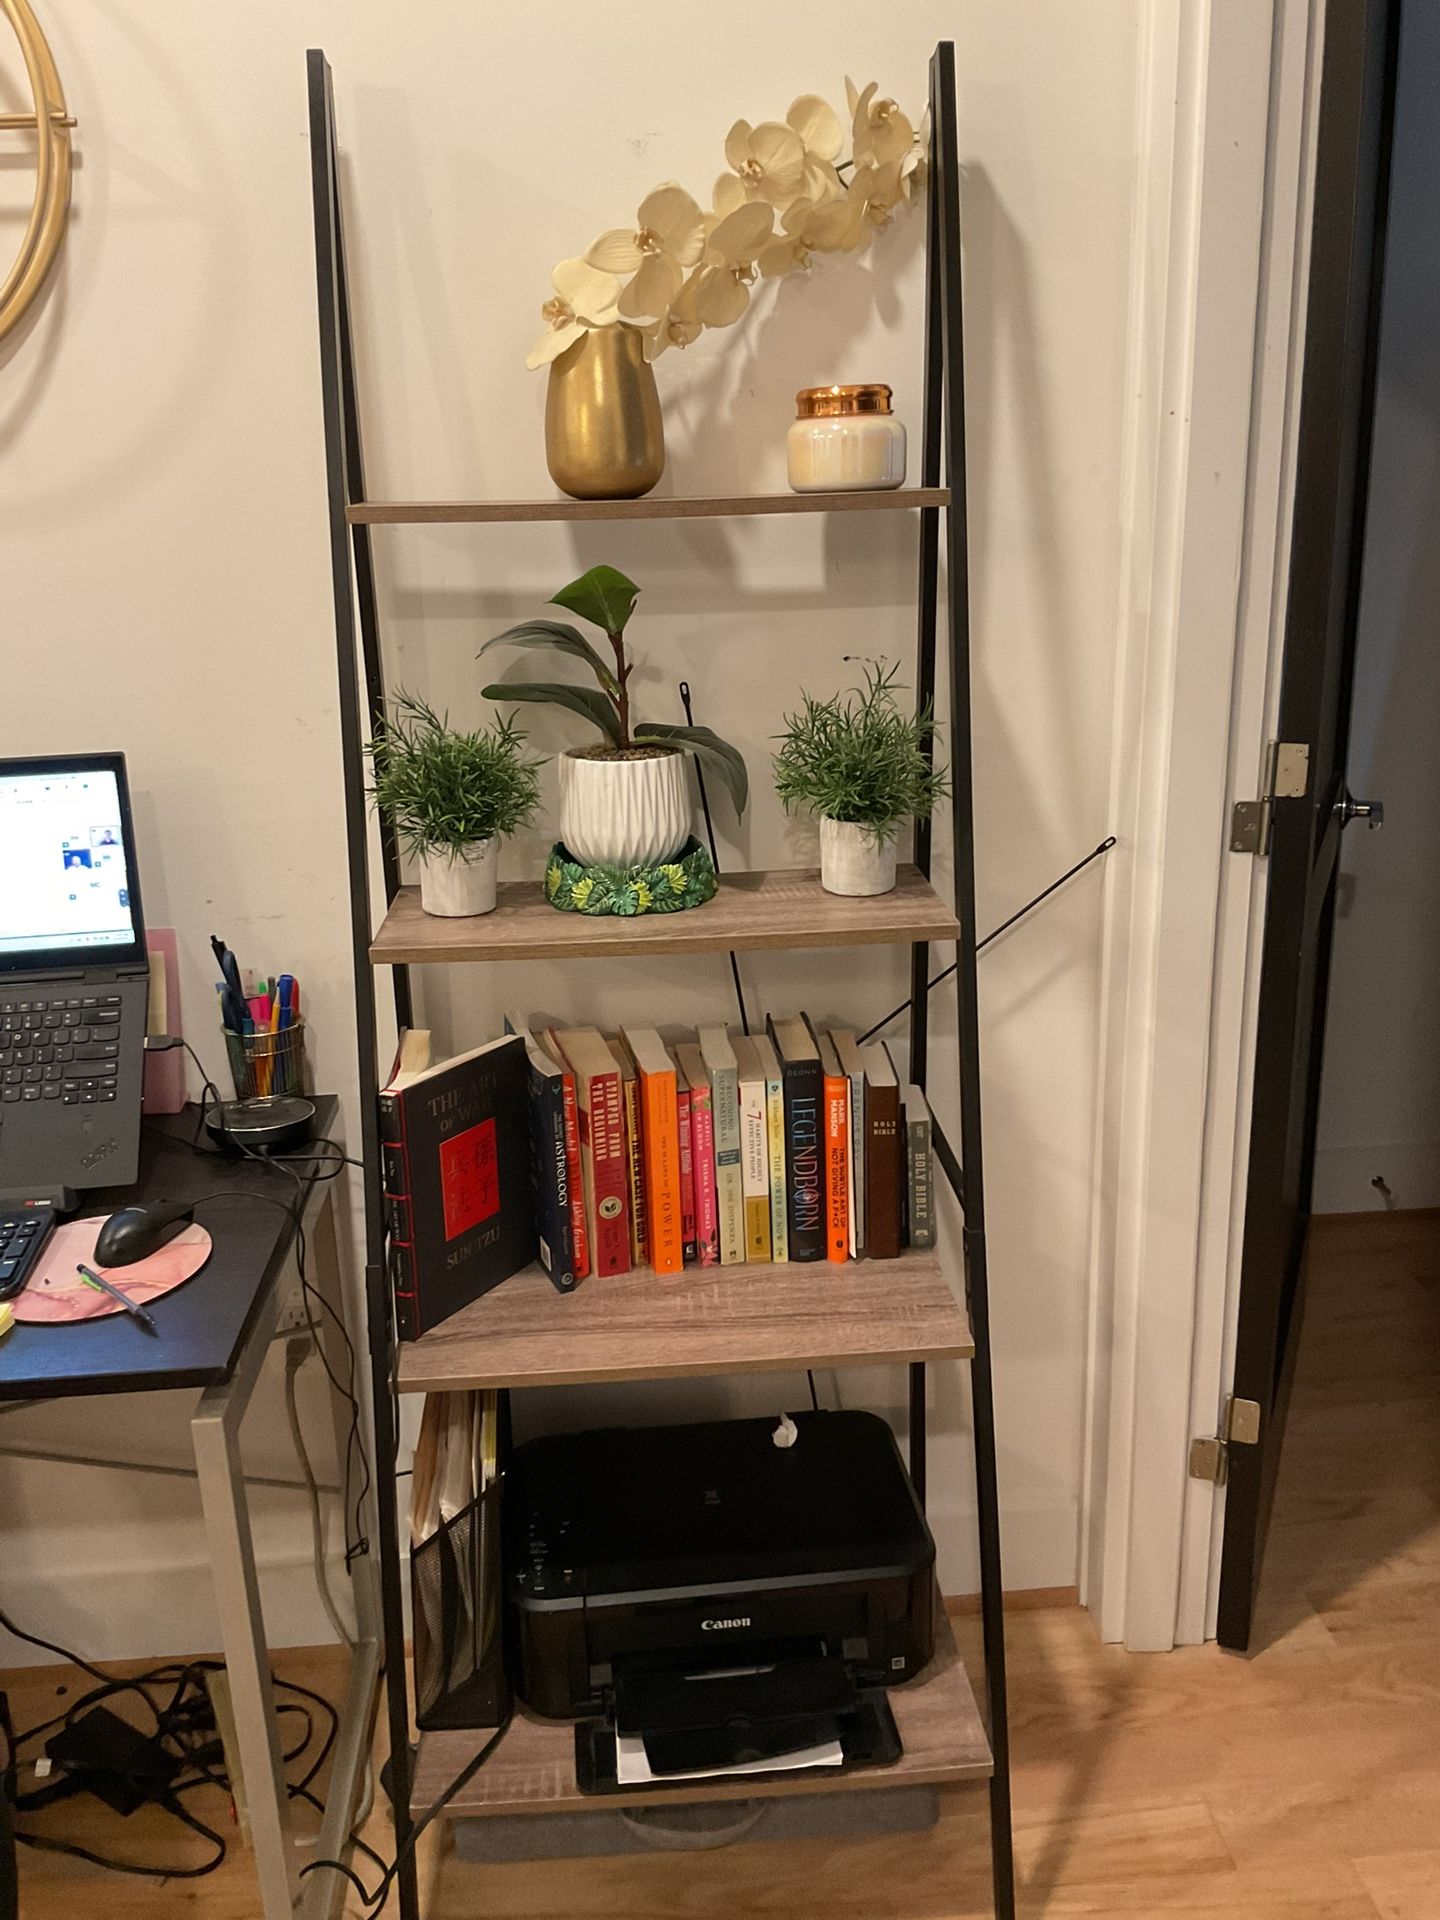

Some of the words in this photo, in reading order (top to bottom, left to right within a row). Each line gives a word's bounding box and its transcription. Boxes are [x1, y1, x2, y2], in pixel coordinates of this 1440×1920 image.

[591, 1083, 604, 1104] THE
[606, 1080, 620, 1126] STAMPED
[719, 1075, 728, 1144] SUPERNATURAL
[747, 1111, 762, 1121] 7
[831, 1099, 839, 1138] MANSON
[838, 1099, 846, 1125] MARK
[593, 1108, 607, 1161] BEGINNING
[608, 1132, 621, 1158] FROM
[555, 1141, 568, 1208] ASTROLOGY
[774, 1155, 782, 1172] THE
[792, 1097, 820, 1232] LEGENDBORN
[915, 1153, 926, 1181] HOLY
[775, 1176, 783, 1205] POWER
[916, 1185, 927, 1219] BIBLE
[662, 1192, 673, 1248] POWER
[776, 1220, 784, 1241] NOW
[701, 1617, 751, 1631] Canon
